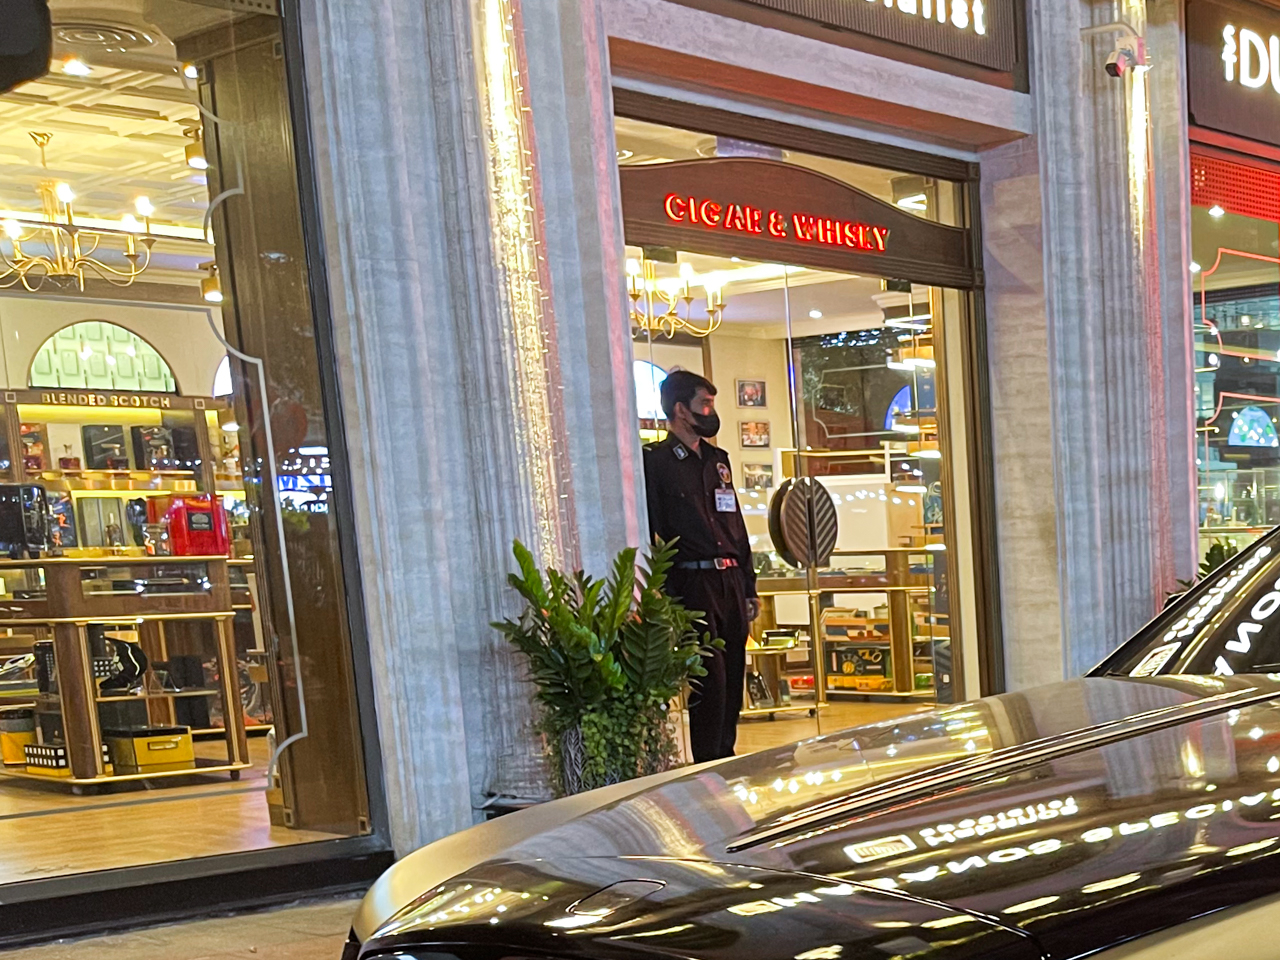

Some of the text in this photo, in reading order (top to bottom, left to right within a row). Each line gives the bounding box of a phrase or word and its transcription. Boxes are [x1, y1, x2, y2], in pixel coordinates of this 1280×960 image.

[664, 193, 891, 251] CIGAR & WHISKY
[42, 393, 171, 408] BLENDED SCOTCH
